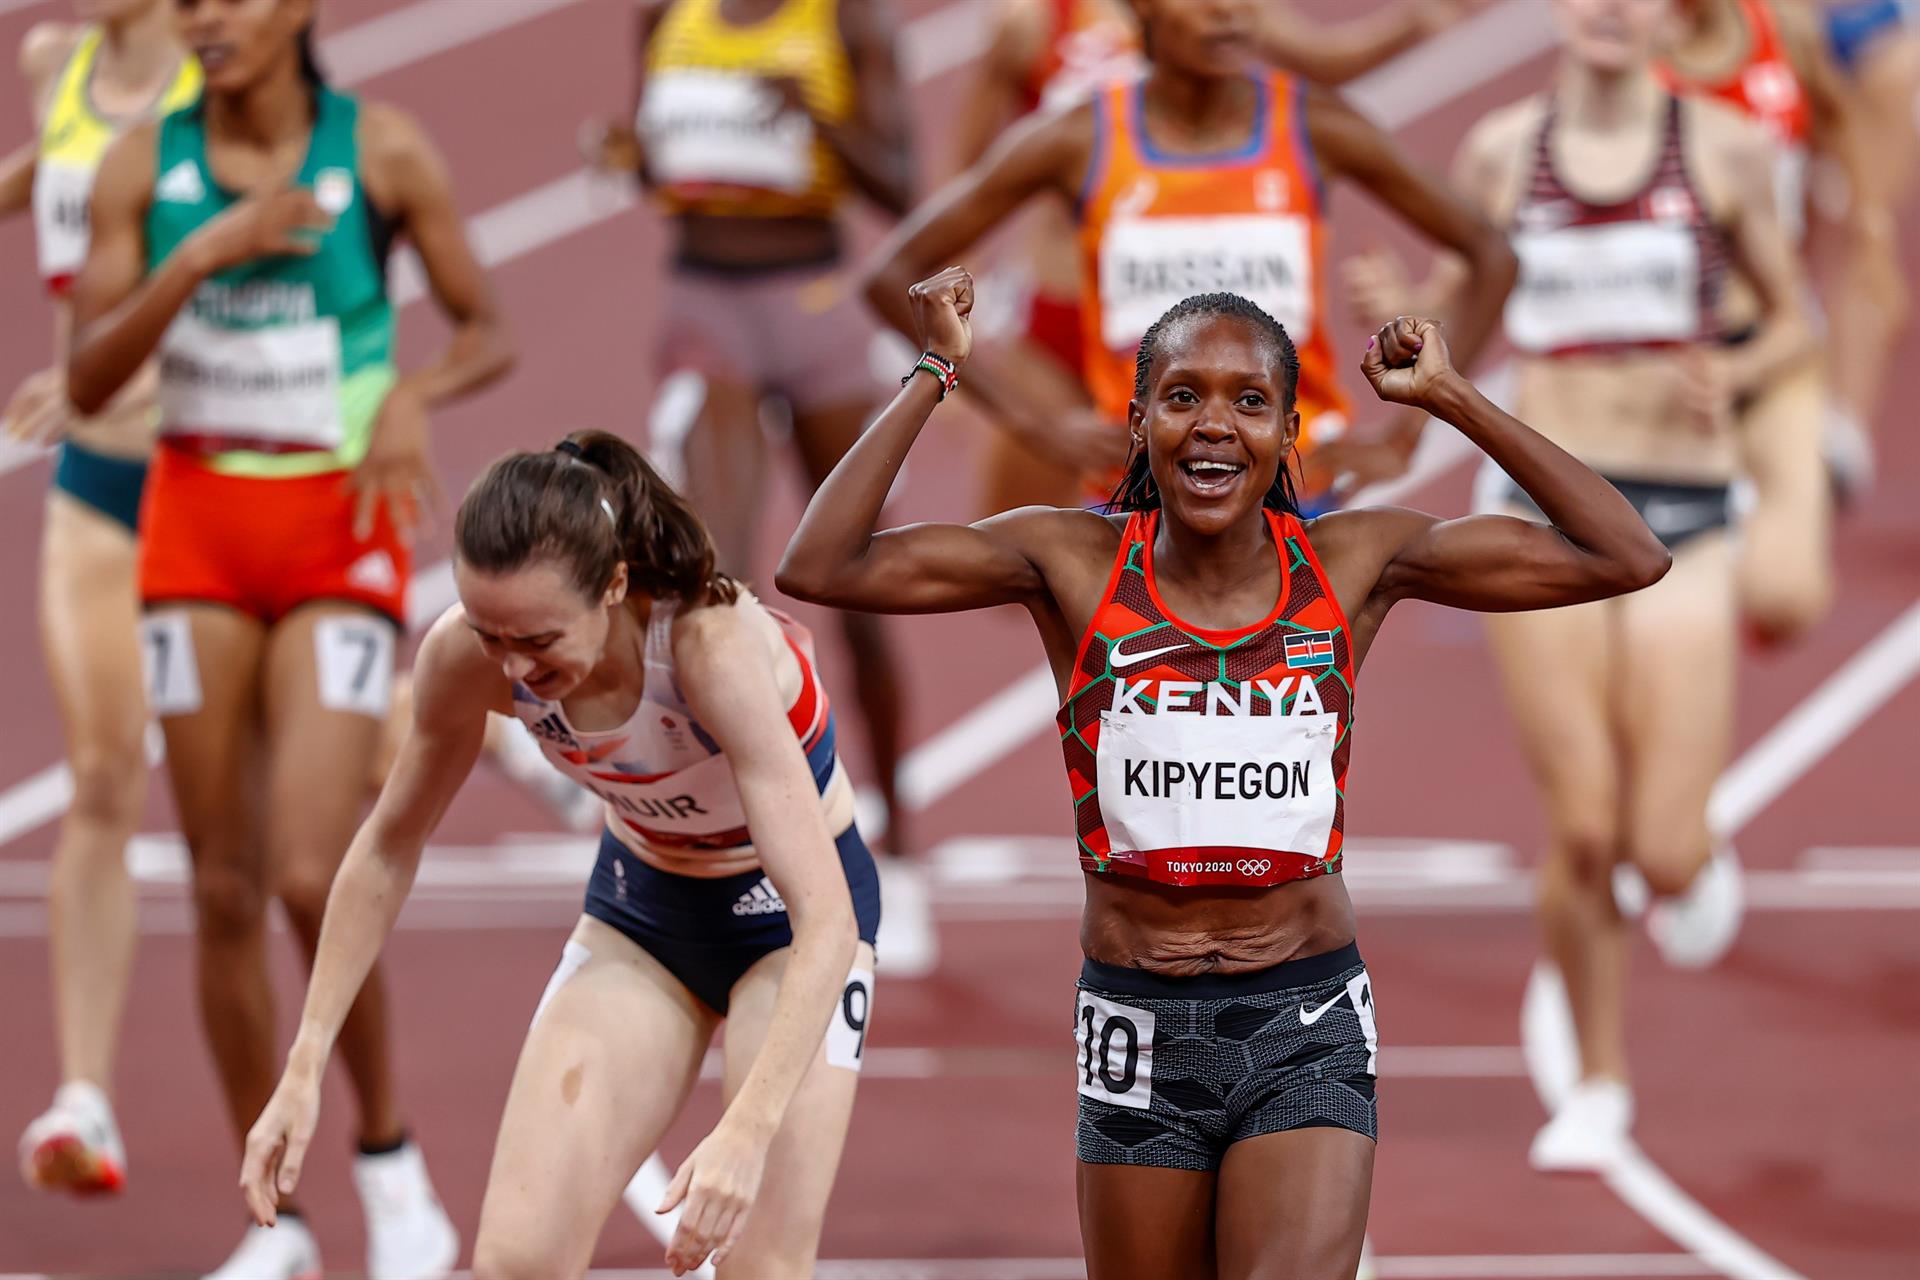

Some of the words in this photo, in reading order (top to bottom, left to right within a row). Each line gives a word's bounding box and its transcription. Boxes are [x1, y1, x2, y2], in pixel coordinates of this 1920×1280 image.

[339, 627, 379, 694] 7
[1110, 674, 1326, 716] KENYA
[1123, 758, 1312, 800] KIPYEGON
[1166, 861, 1203, 873] TOKYO
[1204, 861, 1233, 873] 2020
[732, 898, 787, 917] adida
[842, 980, 868, 1060] 9
[1081, 1004, 1139, 1095] 10
